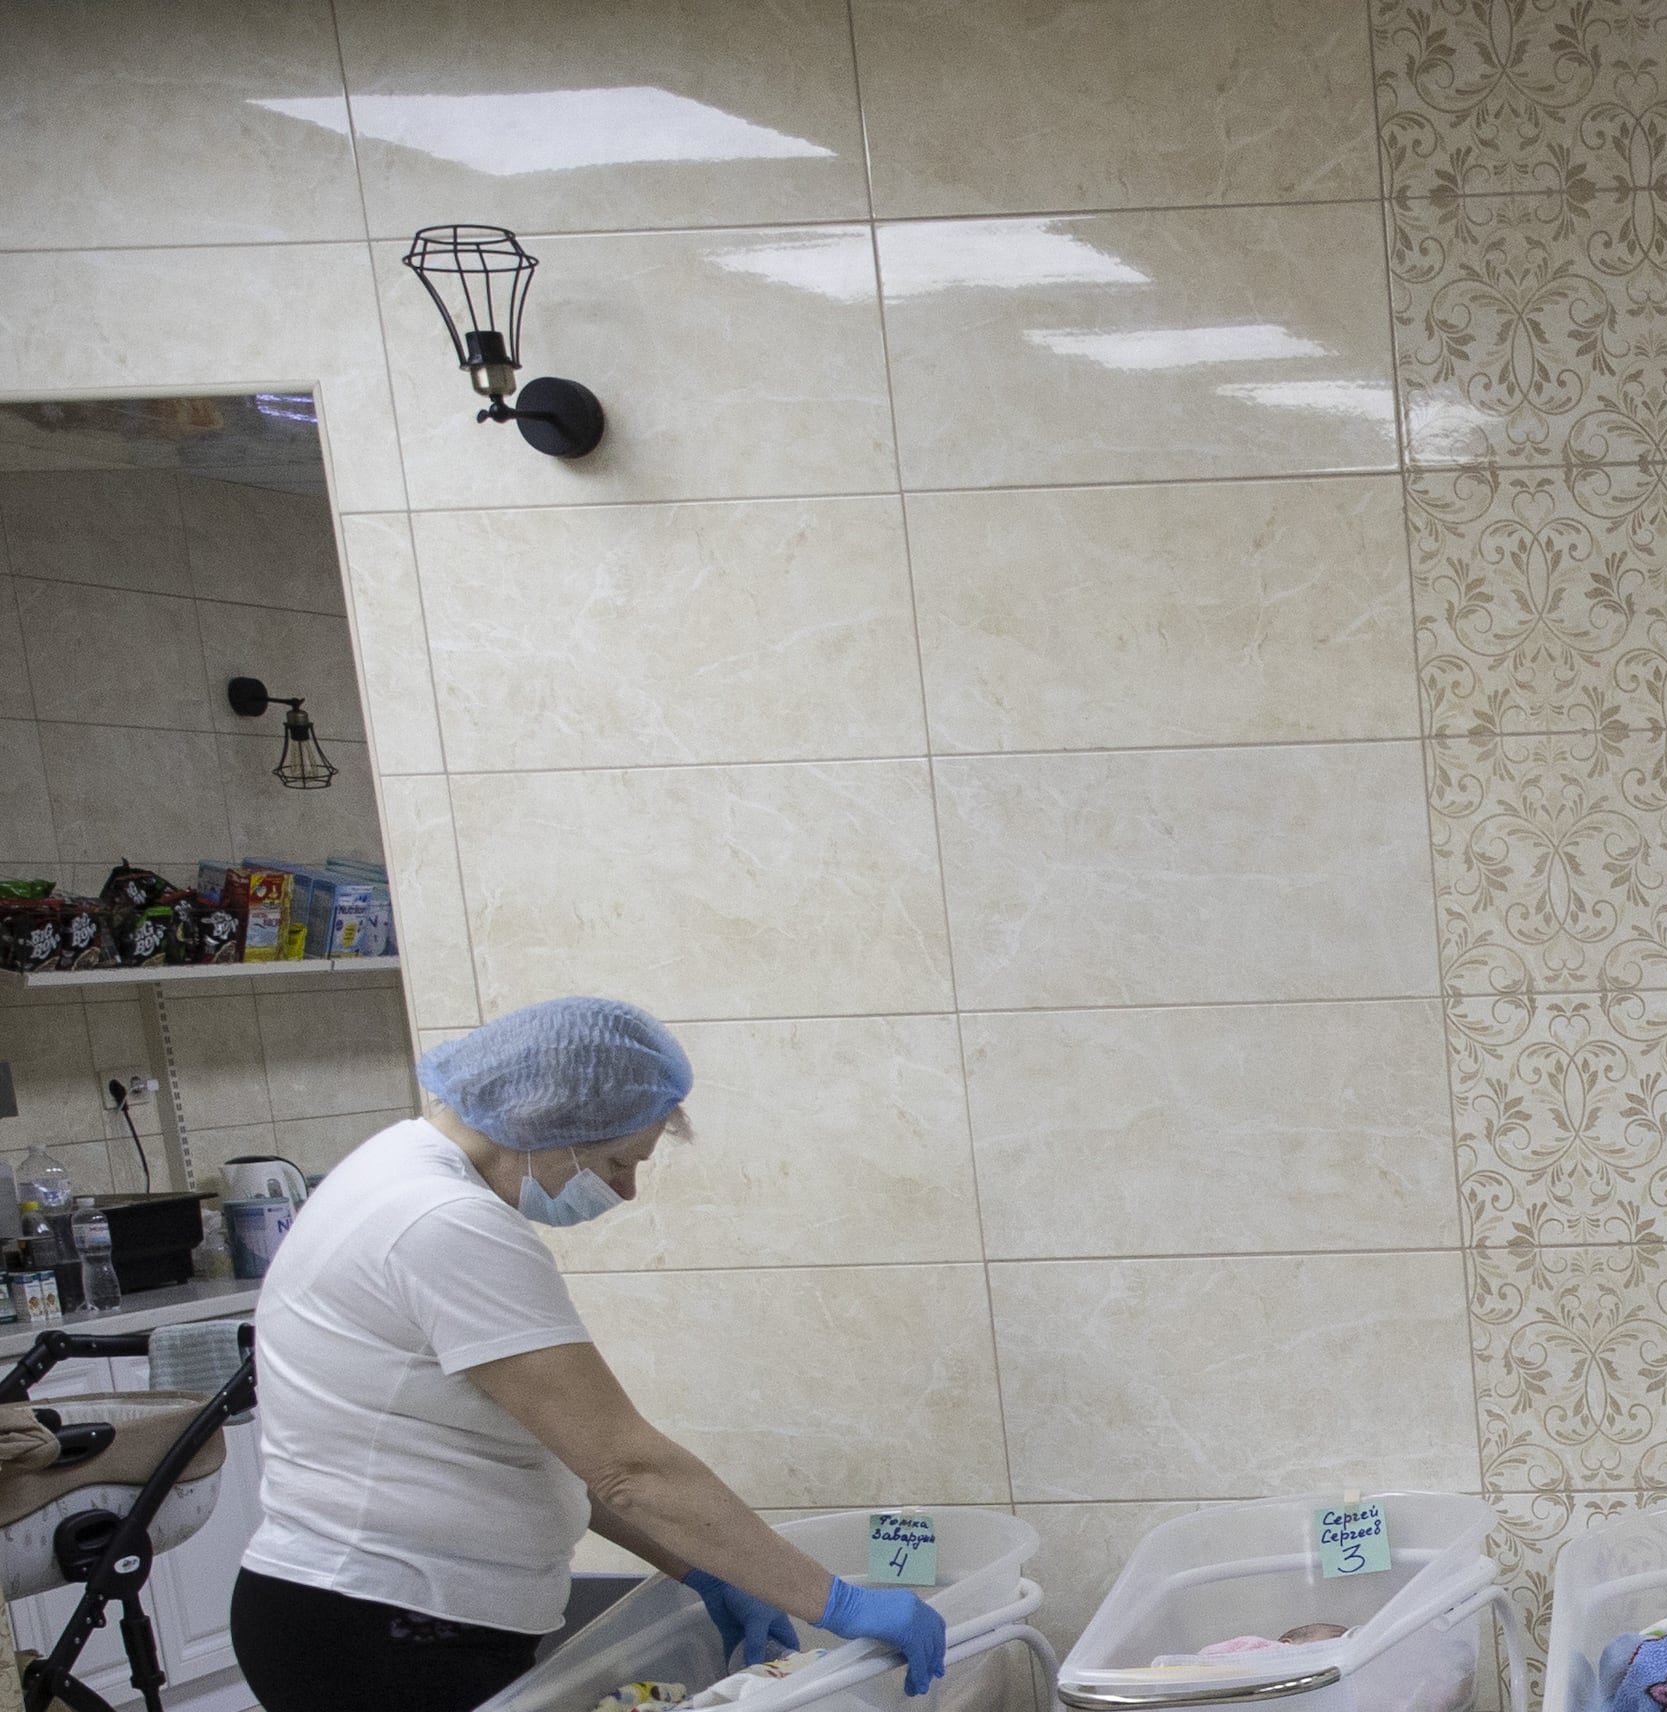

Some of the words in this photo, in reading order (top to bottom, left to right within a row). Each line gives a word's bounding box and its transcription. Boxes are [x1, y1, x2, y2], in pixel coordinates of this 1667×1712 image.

[1323, 1504, 1378, 1531] Сергей
[1321, 1519, 1381, 1547] Сергеев
[889, 1546, 908, 1577] 4
[1337, 1544, 1366, 1573] 3
